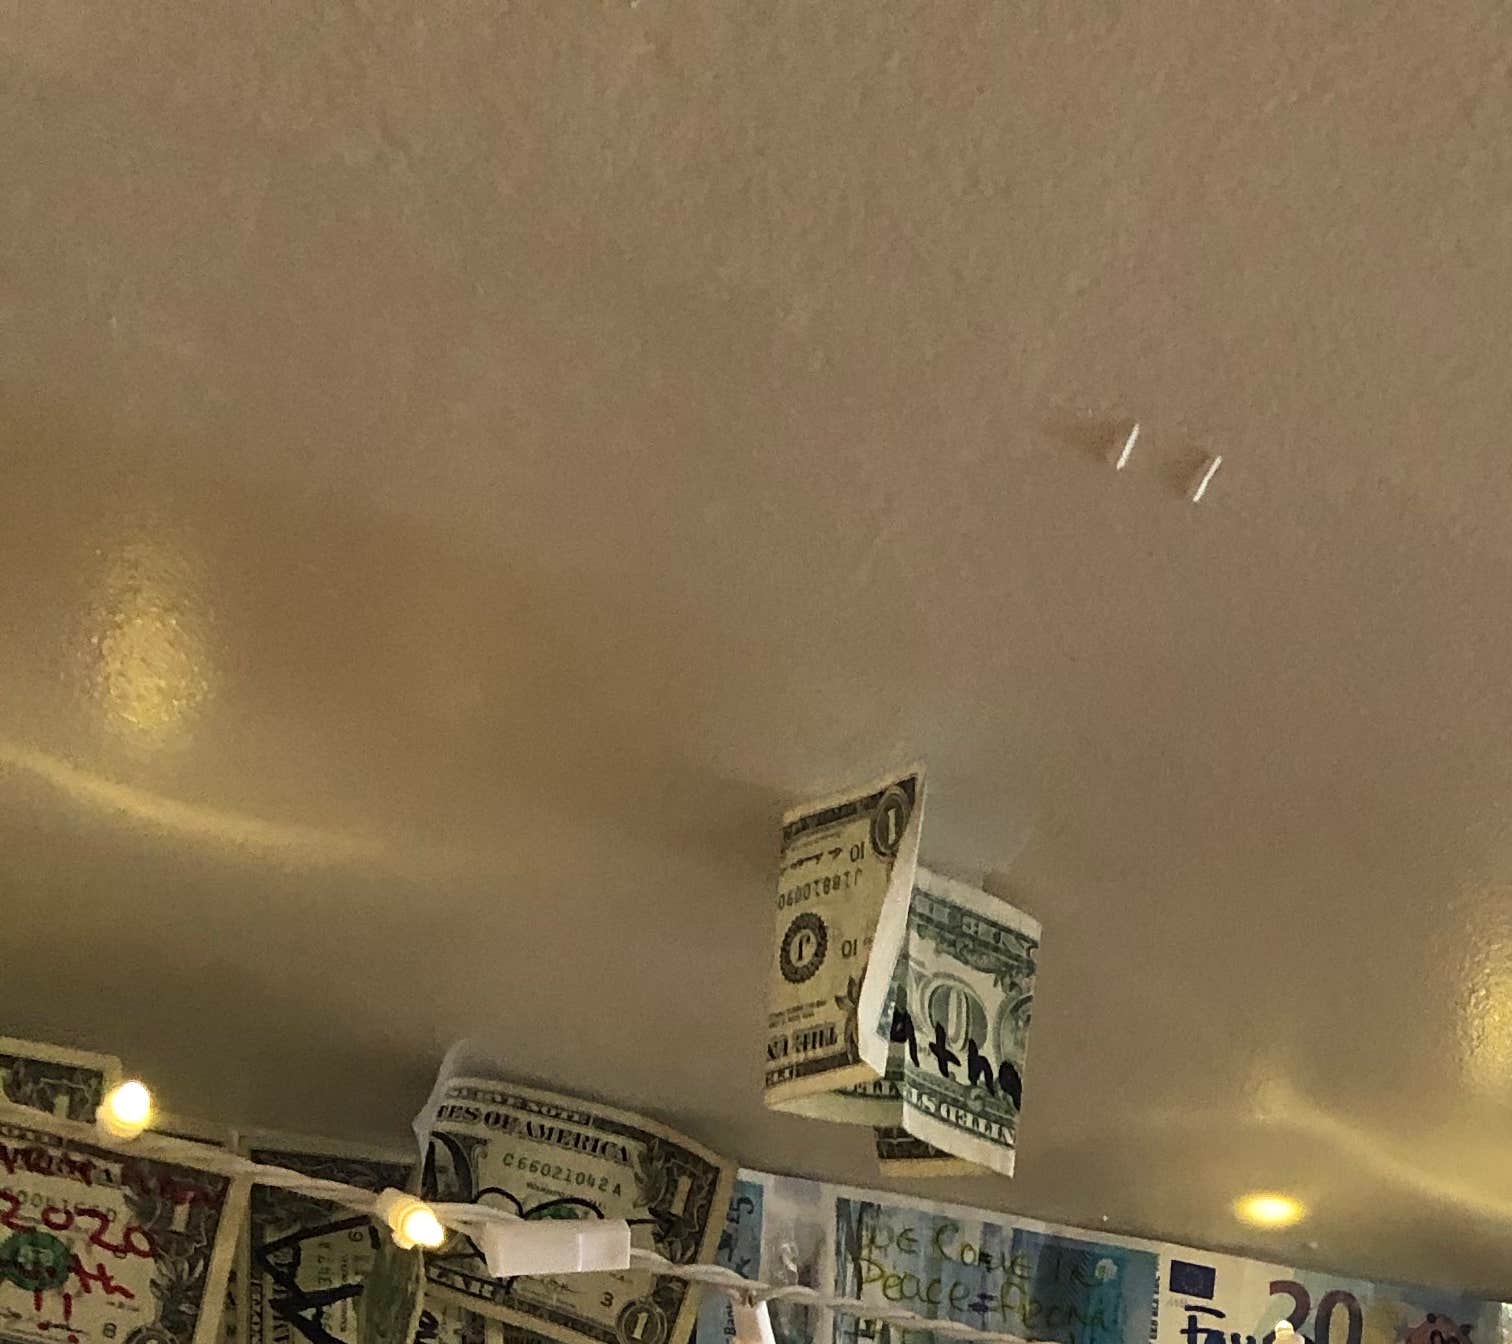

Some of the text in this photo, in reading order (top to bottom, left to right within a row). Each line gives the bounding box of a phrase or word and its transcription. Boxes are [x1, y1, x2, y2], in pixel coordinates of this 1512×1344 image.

[520, 1119, 631, 1162] AMERICA
[940, 1102, 1016, 1145] NITED
[502, 1151, 622, 1197] C66021042A
